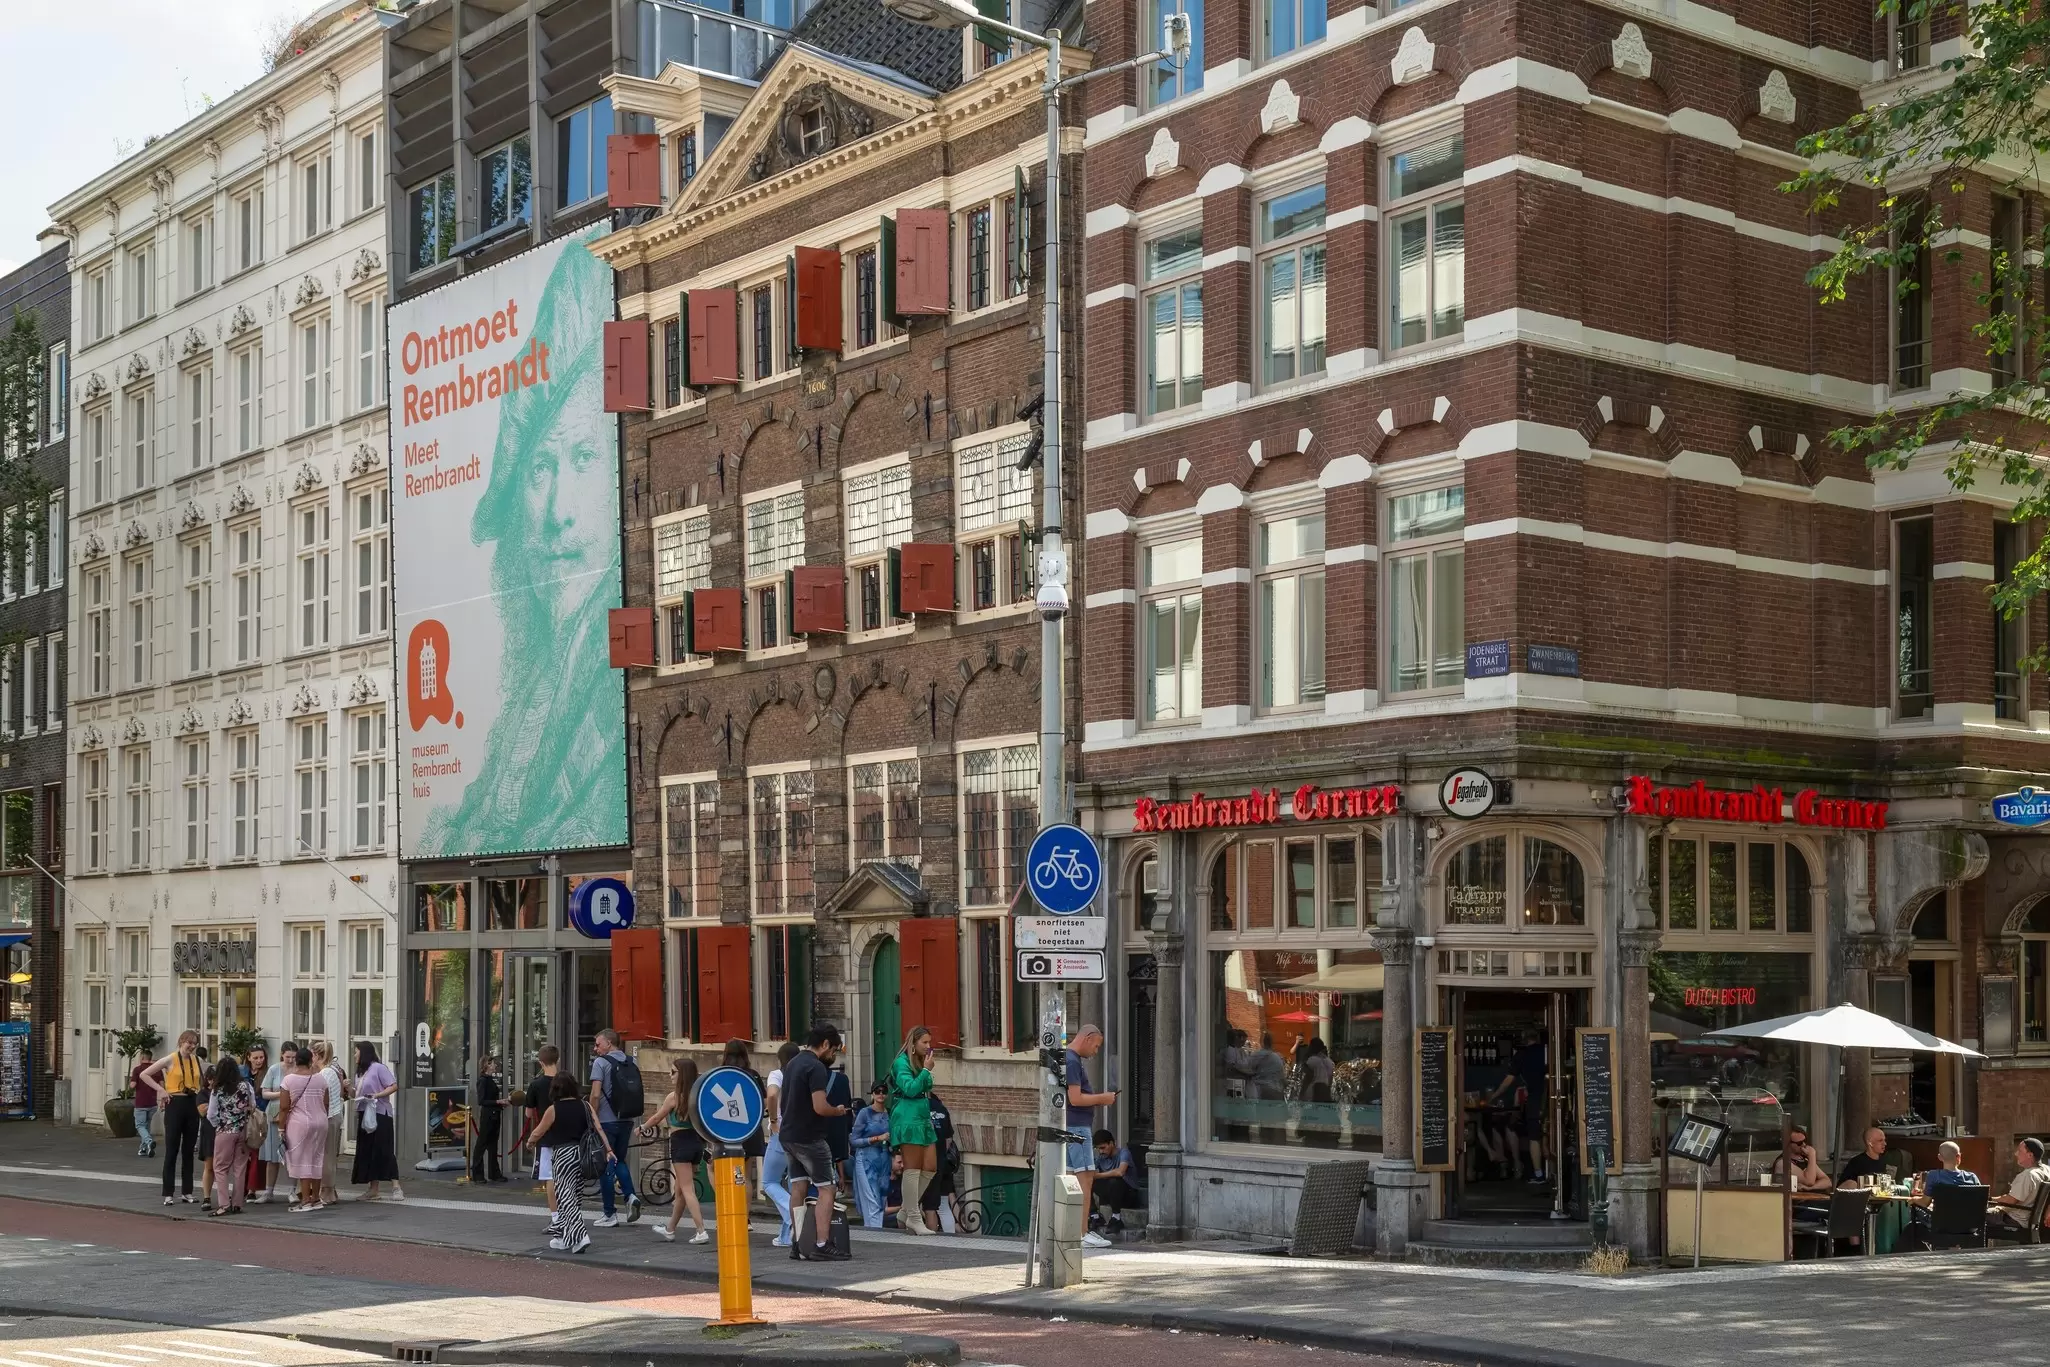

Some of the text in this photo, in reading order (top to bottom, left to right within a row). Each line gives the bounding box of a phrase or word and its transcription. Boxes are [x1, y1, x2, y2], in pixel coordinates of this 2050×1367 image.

[402, 298, 518, 375] Ontmoet
[404, 337, 550, 426] Rembrandt
[808, 380, 826, 394] 1606
[404, 438, 439, 468] Meet
[405, 454, 480, 498] Rembrandt
[1469, 644, 1506, 658] JODENBREE
[1532, 649, 1576, 662] ZWANENBURG
[1476, 656, 1498, 667] STRAAT
[1532, 661, 1544, 671] WAL
[412, 743, 449, 758] museum
[412, 758, 461, 778] Rembrandt
[413, 782, 430, 798] huis
[1448, 776, 1488, 804] Segafredo
[1132, 783, 1401, 833] Rembrandt Corner
[1624, 775, 1888, 830] Rembrandt Corner
[1447, 886, 1463, 907] La
[1038, 938, 1085, 946] toegestaan
[1275, 952, 1292, 969] Wifi
[1268, 988, 1301, 1006] DUTCH
[1685, 987, 1756, 1005] DUTCH BISTRO
